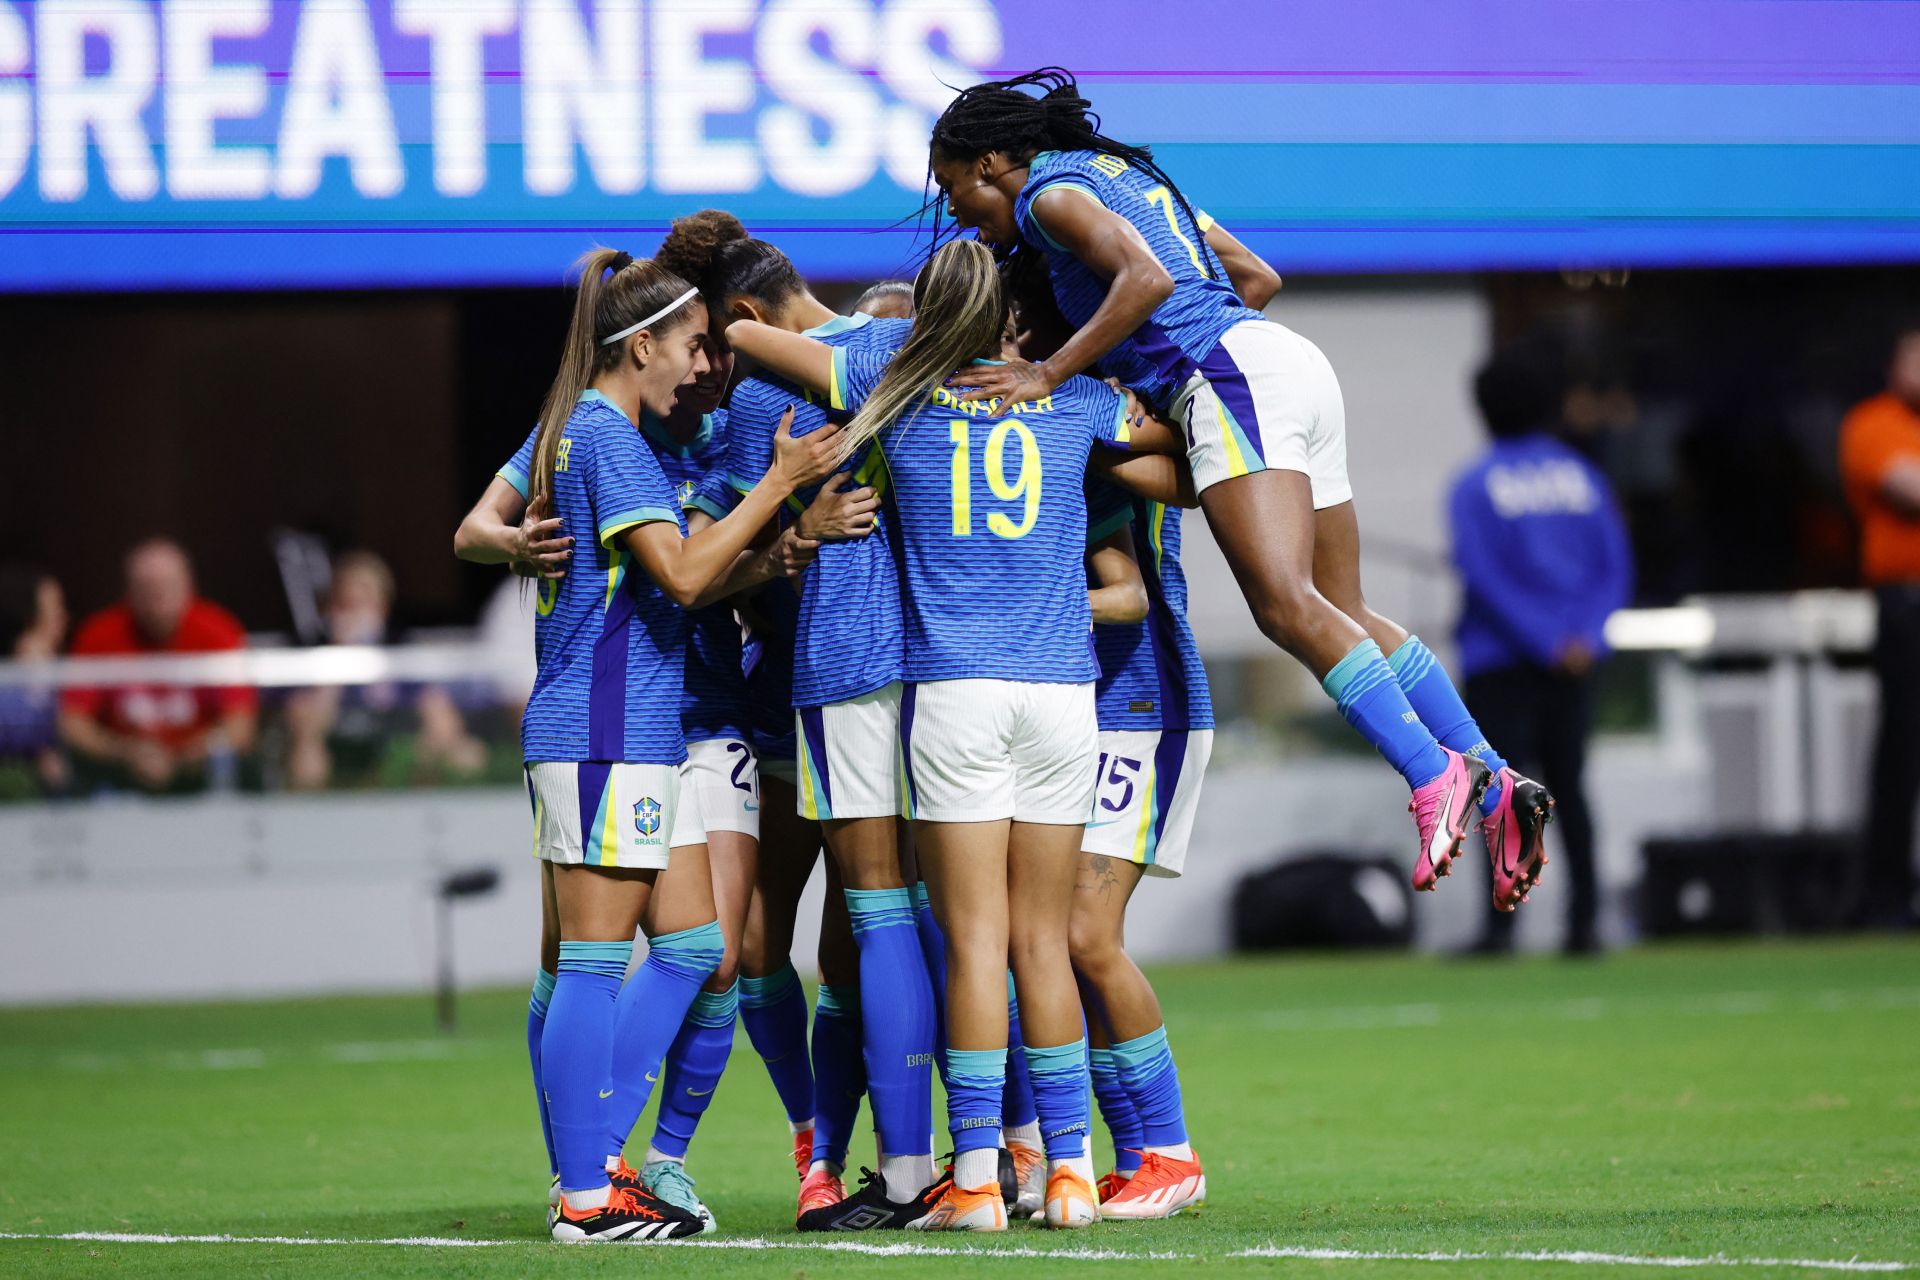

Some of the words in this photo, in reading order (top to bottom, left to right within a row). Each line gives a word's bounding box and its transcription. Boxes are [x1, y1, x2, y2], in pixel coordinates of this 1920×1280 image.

[0, 0, 1004, 201] REATNESS
[1145, 186, 1209, 279] 7
[1184, 395, 1196, 449] 7
[950, 418, 1043, 539] 19
[1096, 752, 1142, 812] 15
[634, 838, 663, 846] BRASIL
